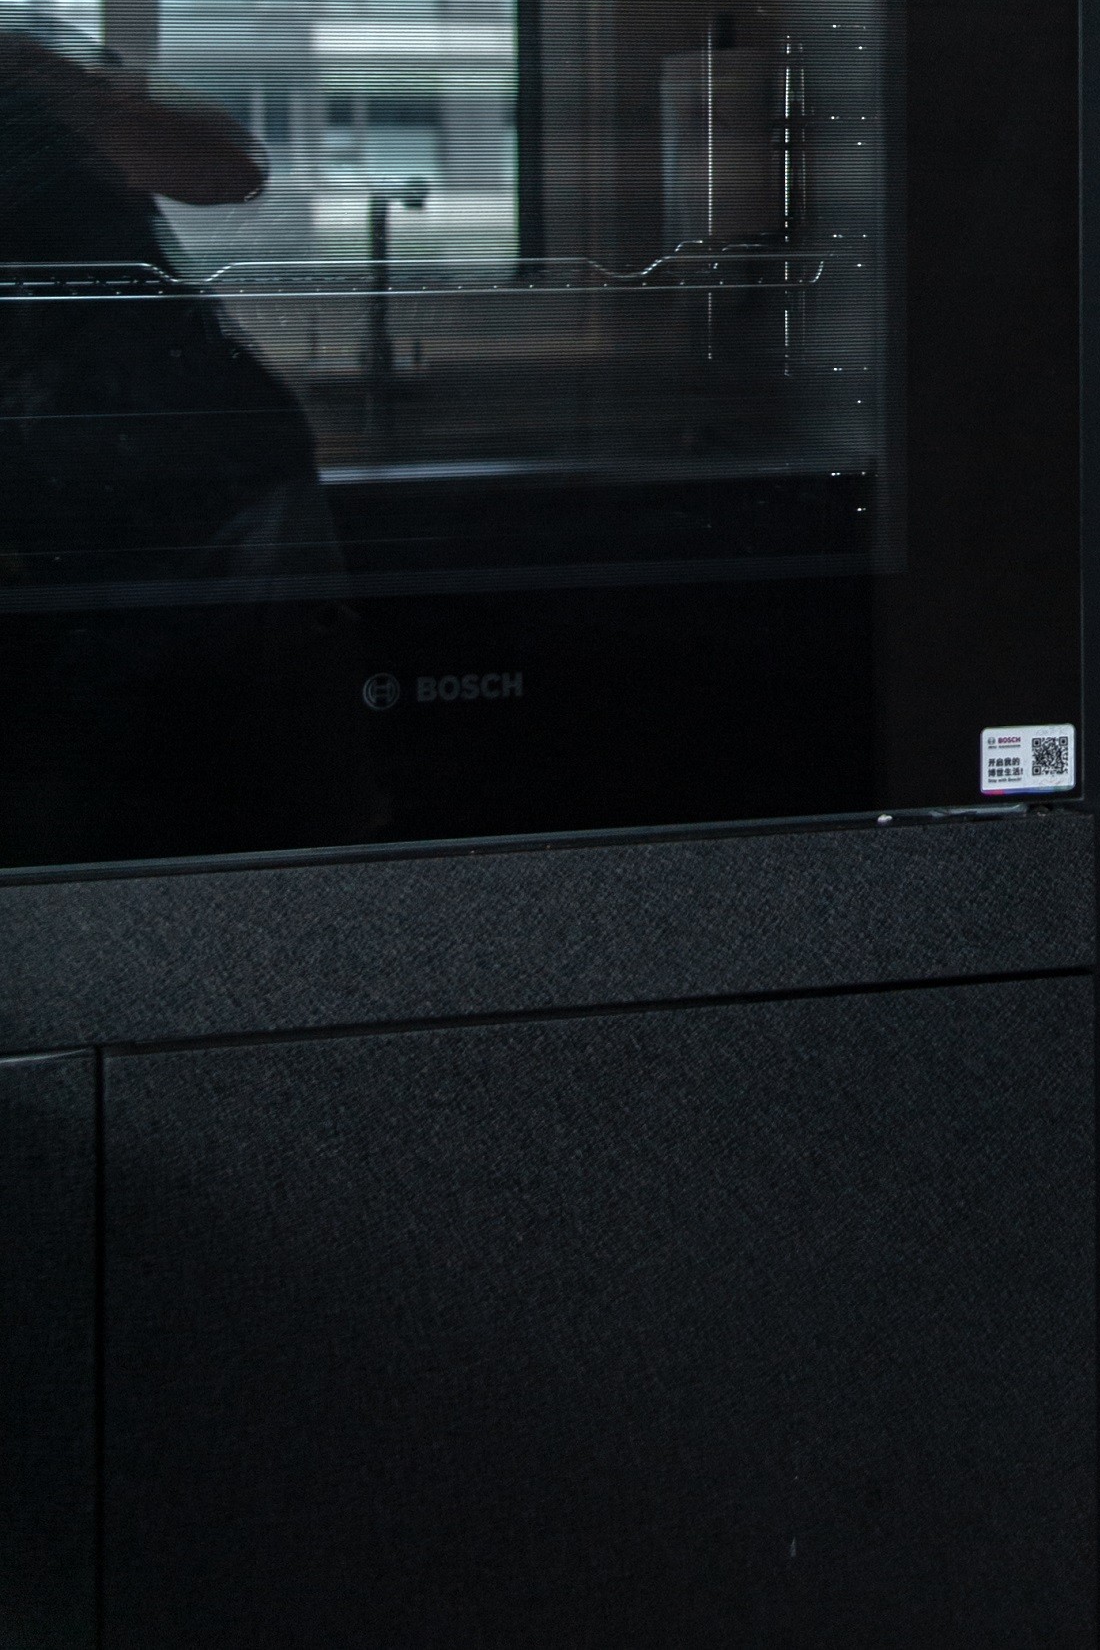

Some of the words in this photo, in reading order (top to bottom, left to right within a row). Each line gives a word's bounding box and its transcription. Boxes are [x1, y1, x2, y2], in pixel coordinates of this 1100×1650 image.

[416, 670, 525, 703] BOSCH
[998, 736, 1021, 744] BOSCH
[988, 757, 1020, 768] 开启我的
